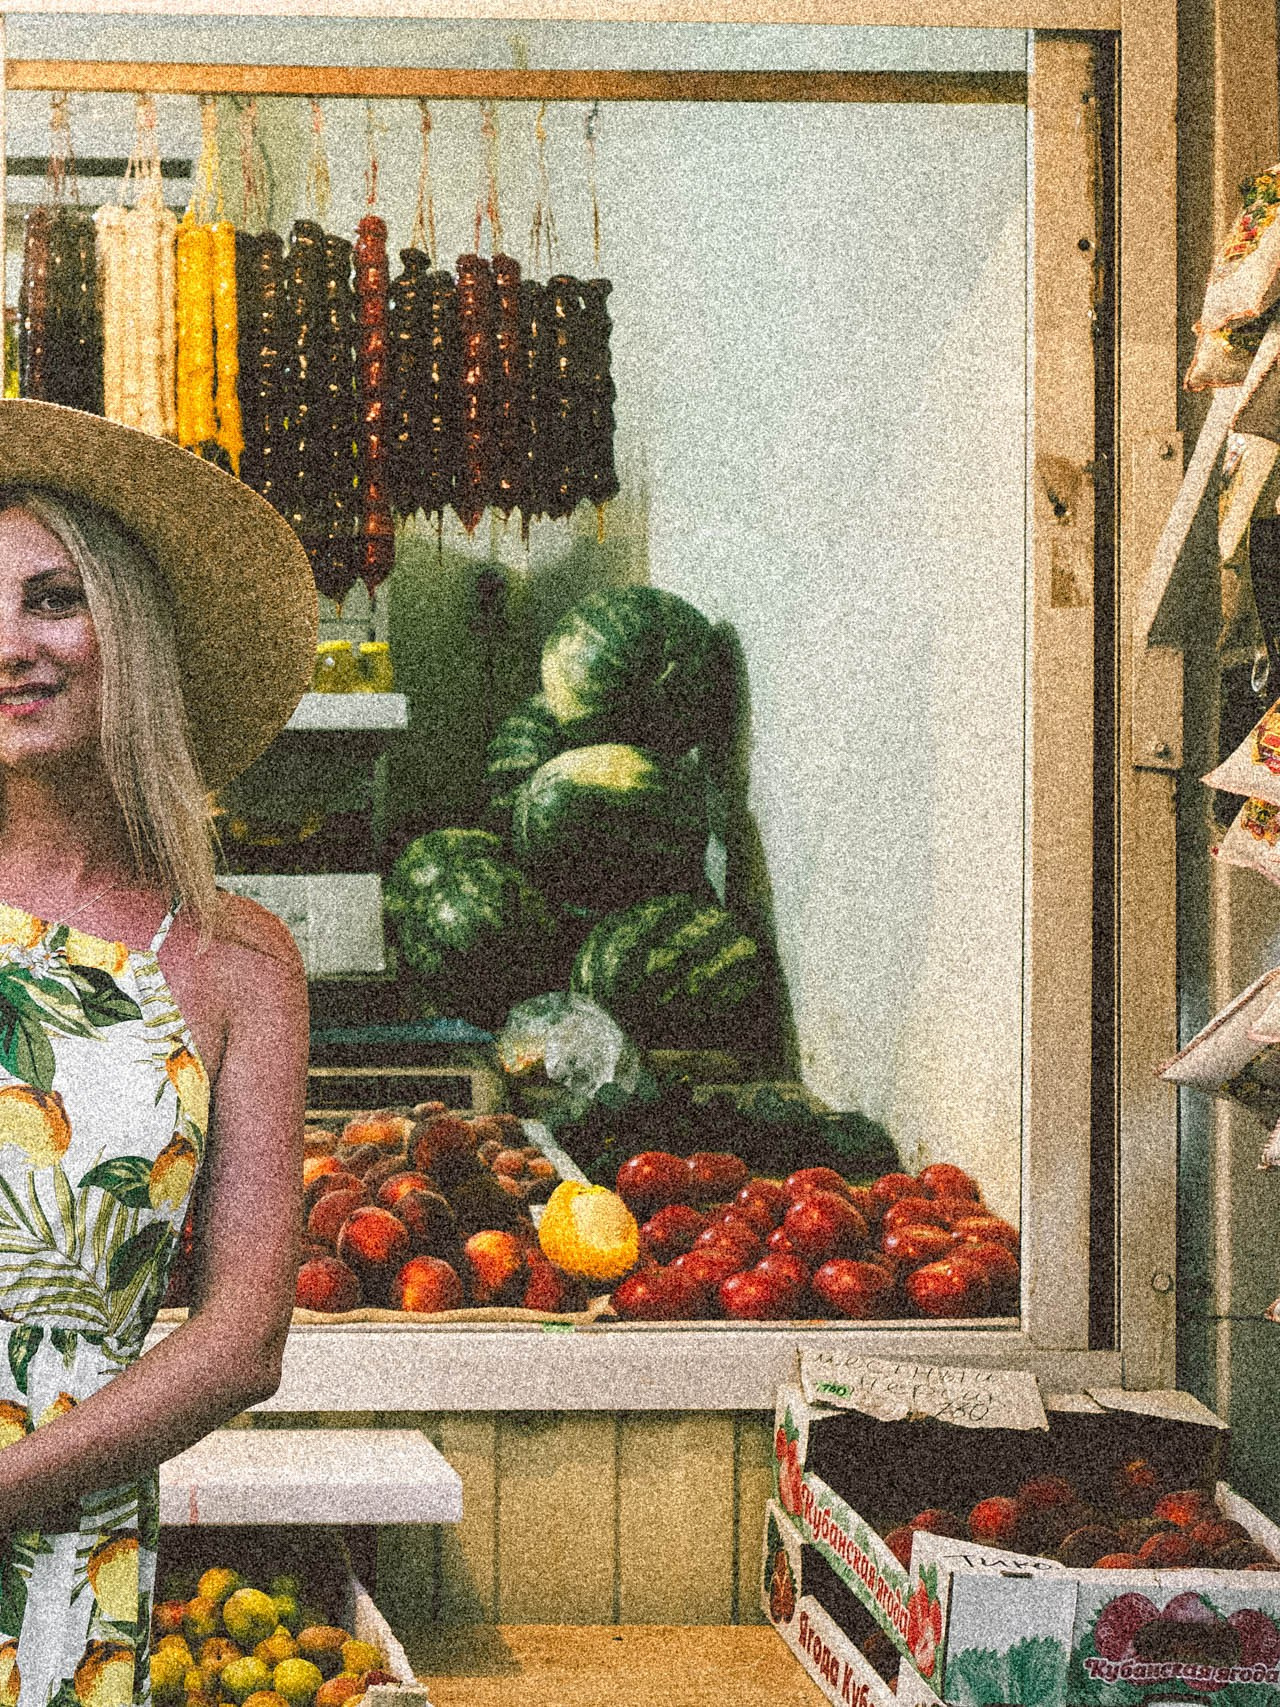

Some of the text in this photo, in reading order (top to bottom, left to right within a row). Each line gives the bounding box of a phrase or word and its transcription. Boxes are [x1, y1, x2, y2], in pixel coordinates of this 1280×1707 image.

[801, 1483, 877, 1591] Кубанская
[798, 1610, 840, 1690] Ягода
[1083, 1657, 1214, 1683] Кубанская
